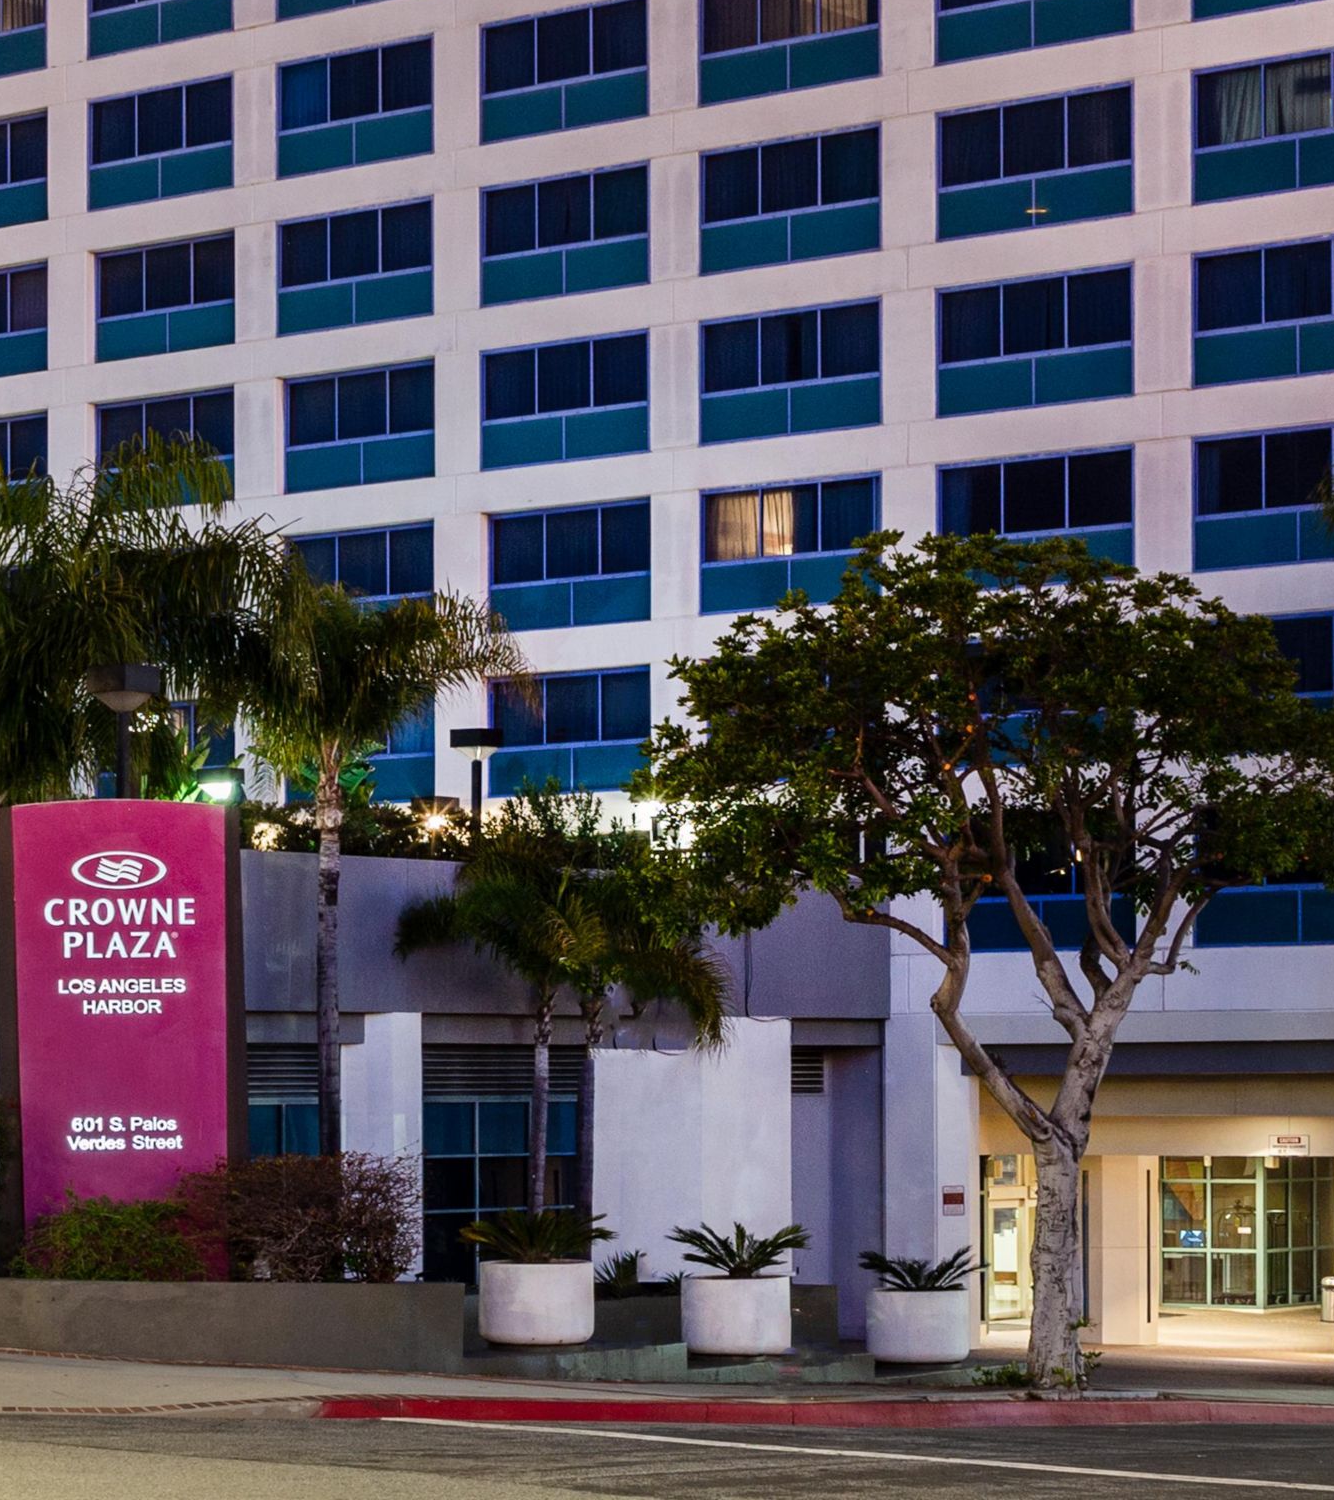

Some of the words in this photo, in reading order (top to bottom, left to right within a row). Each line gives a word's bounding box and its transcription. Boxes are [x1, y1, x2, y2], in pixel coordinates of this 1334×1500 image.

[43, 897, 196, 927] CROWNE
[63, 931, 177, 959] PLAZA
[58, 978, 96, 994] LOS
[98, 977, 187, 994] ANGELES
[82, 999, 163, 1015] HARBOR
[71, 1116, 103, 1132] 601
[109, 1116, 126, 1132] S.
[130, 1116, 178, 1132] Palos
[66, 1134, 127, 1151] Verdes
[132, 1134, 184, 1150] Street
